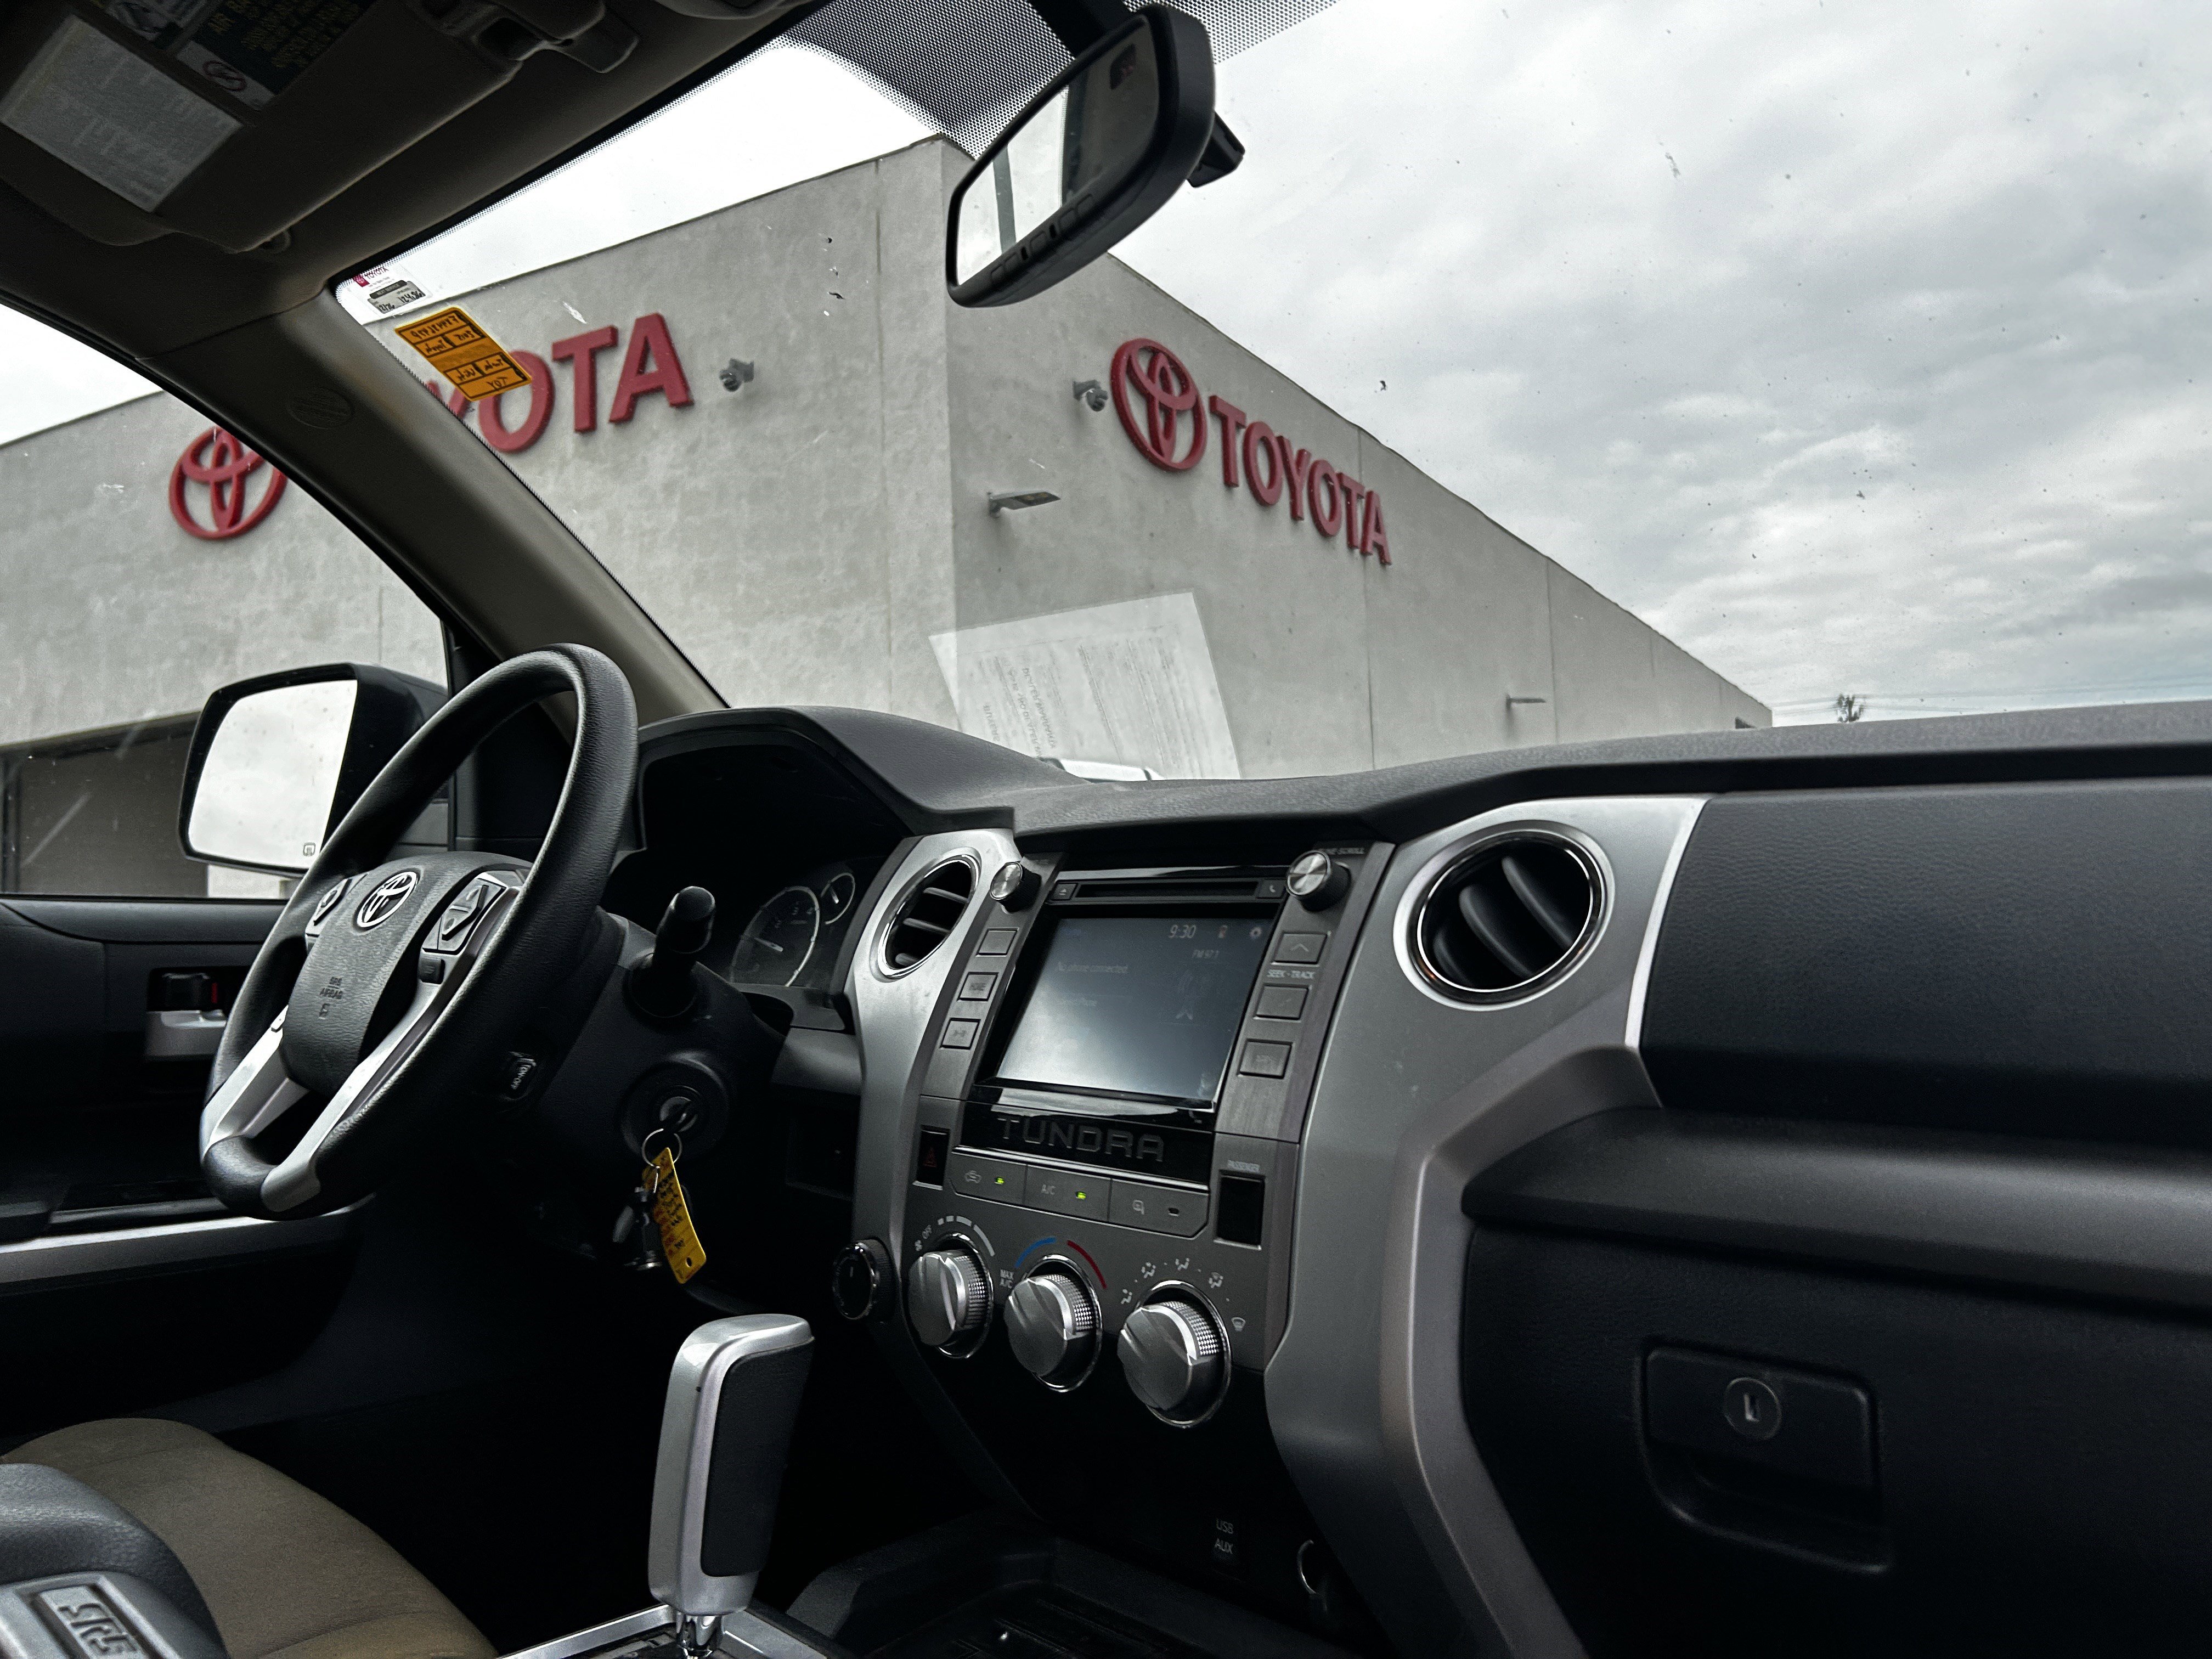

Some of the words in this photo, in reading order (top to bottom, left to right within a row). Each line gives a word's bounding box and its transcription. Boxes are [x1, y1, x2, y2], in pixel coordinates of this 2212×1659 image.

[1209, 395, 1392, 566] TOYOTA
[1169, 924, 1197, 939] 9:30
[996, 1115, 1165, 1162] TUNDRA
[1041, 1183, 1056, 1196] A/C
[1000, 1268, 1015, 1280] MAX
[1216, 1518, 1233, 1534] USB
[1214, 1538, 1233, 1555] AUX
